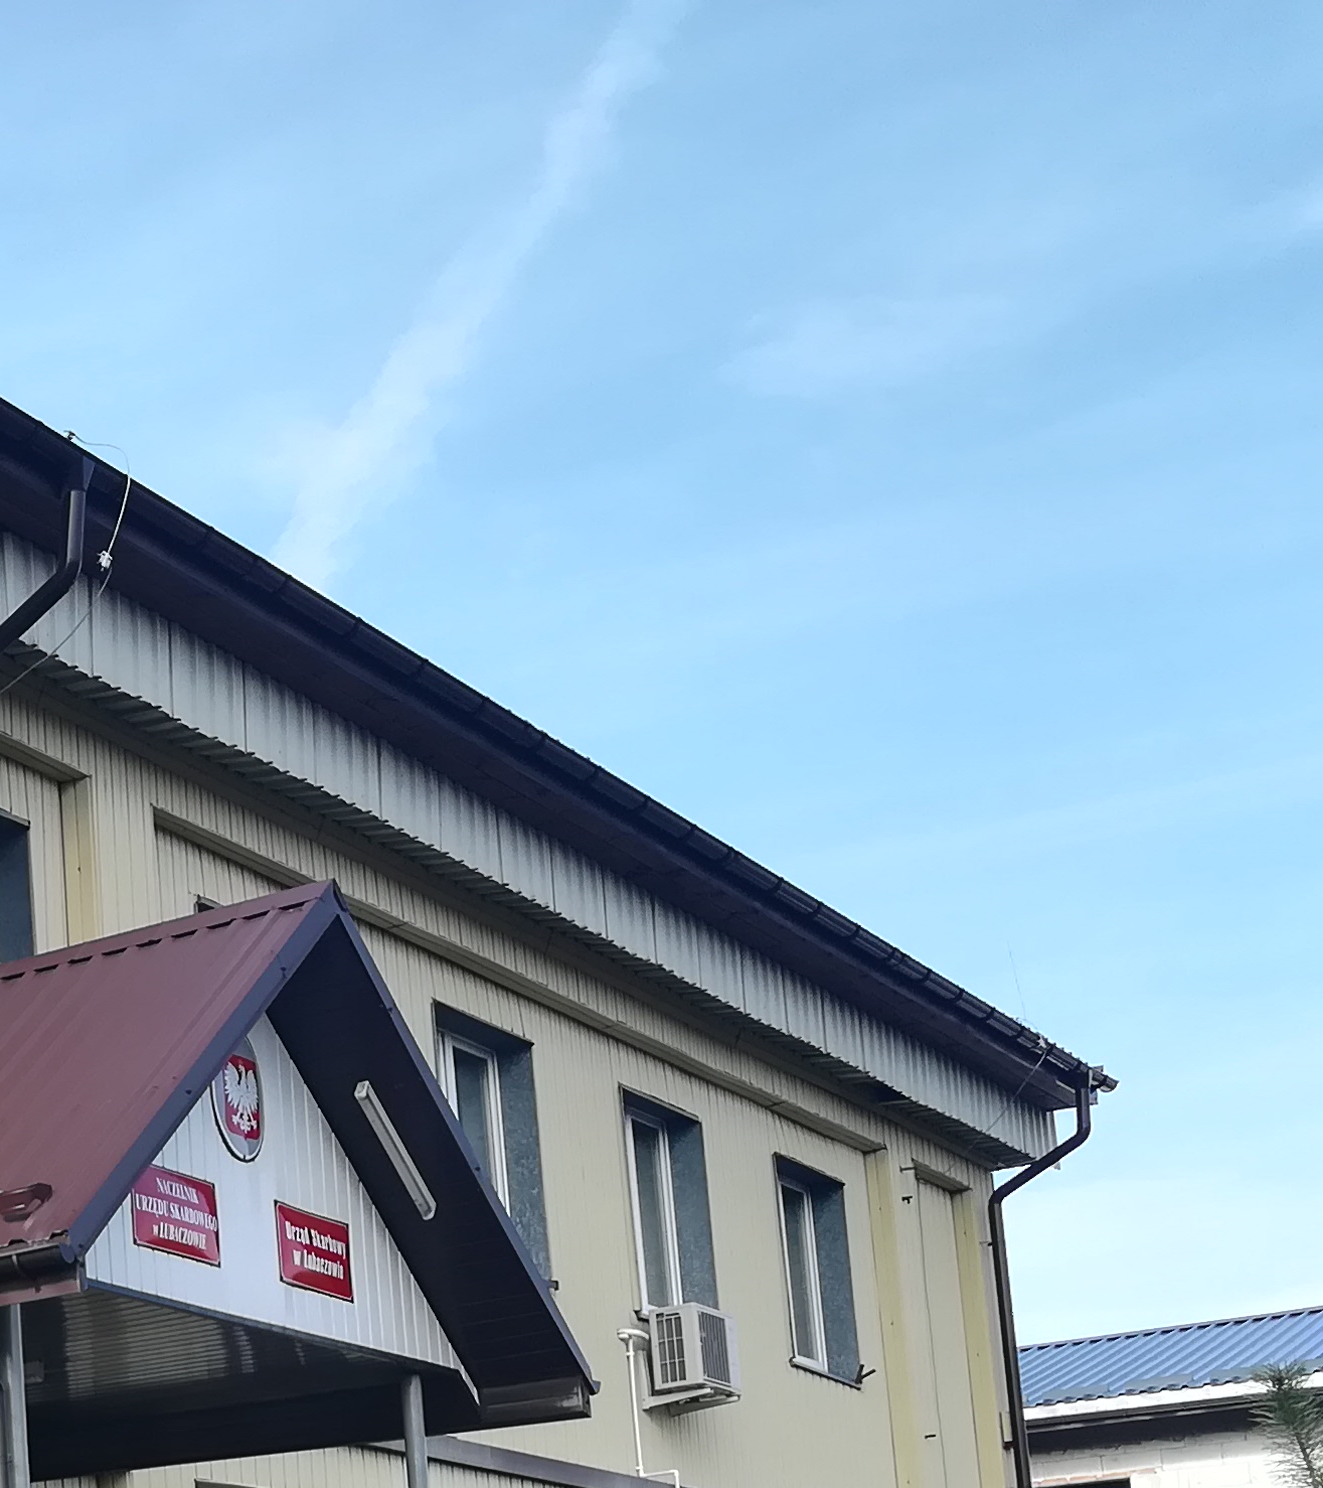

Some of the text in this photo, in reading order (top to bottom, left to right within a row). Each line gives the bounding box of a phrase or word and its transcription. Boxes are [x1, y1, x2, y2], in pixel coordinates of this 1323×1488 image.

[156, 1177, 199, 1204] NACZELNIK
[135, 1193, 218, 1231] URZĘDU SKARBOWEGO
[159, 1222, 207, 1250] LUBACZOWIE
[285, 1221, 346, 1260] Urząd Skarbowy
[293, 1249, 344, 1280] w Lubaczowie
